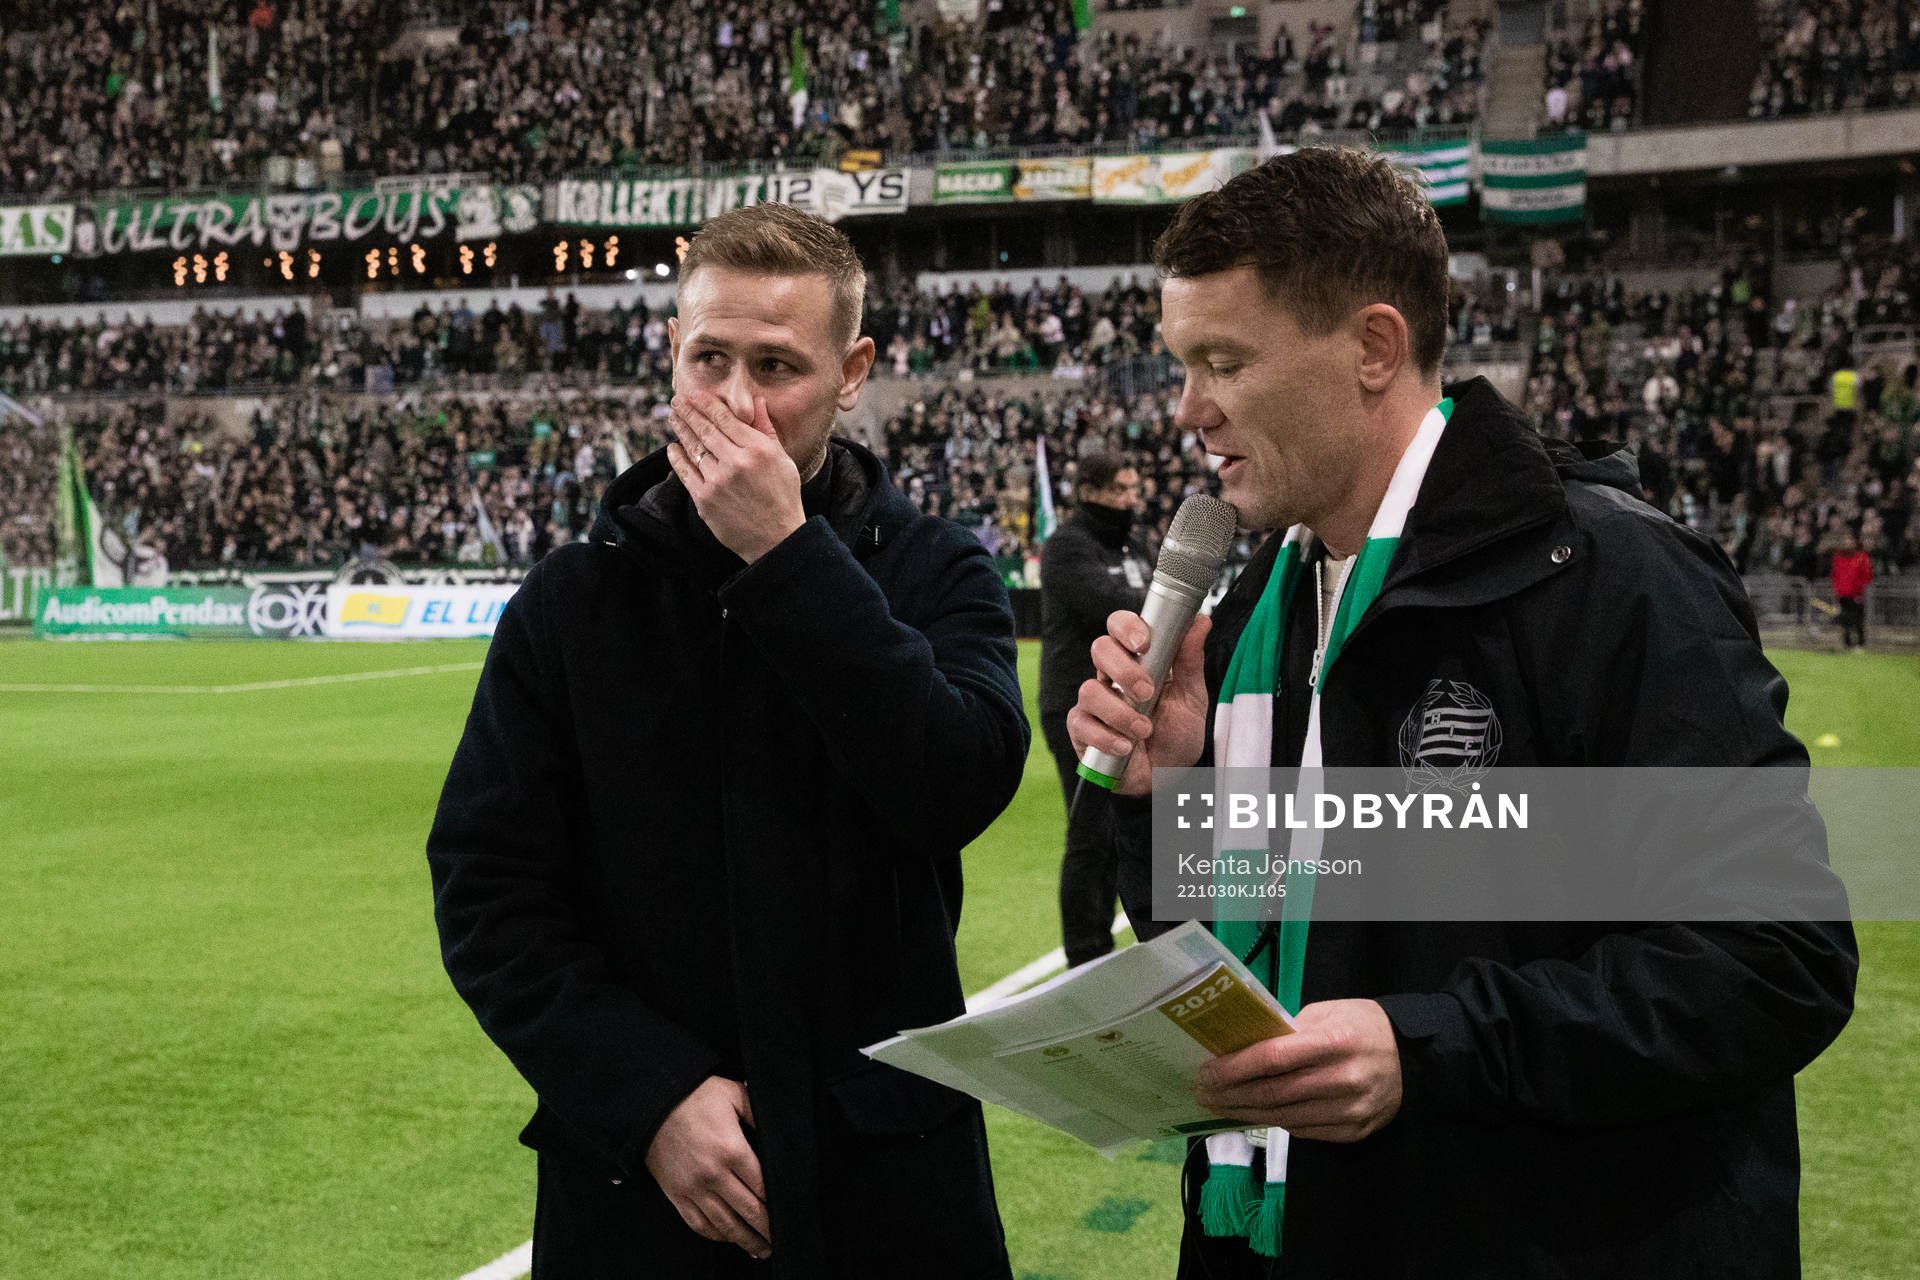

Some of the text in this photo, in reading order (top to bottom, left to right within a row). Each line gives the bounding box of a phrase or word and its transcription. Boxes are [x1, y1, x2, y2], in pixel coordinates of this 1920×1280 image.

[852, 172, 904, 201] YS
[103, 186, 450, 255] ULTRA BOYS
[43, 596, 245, 625] AudicomPendax
[421, 600, 454, 624] EL
[1169, 975, 1235, 1018] 2022
